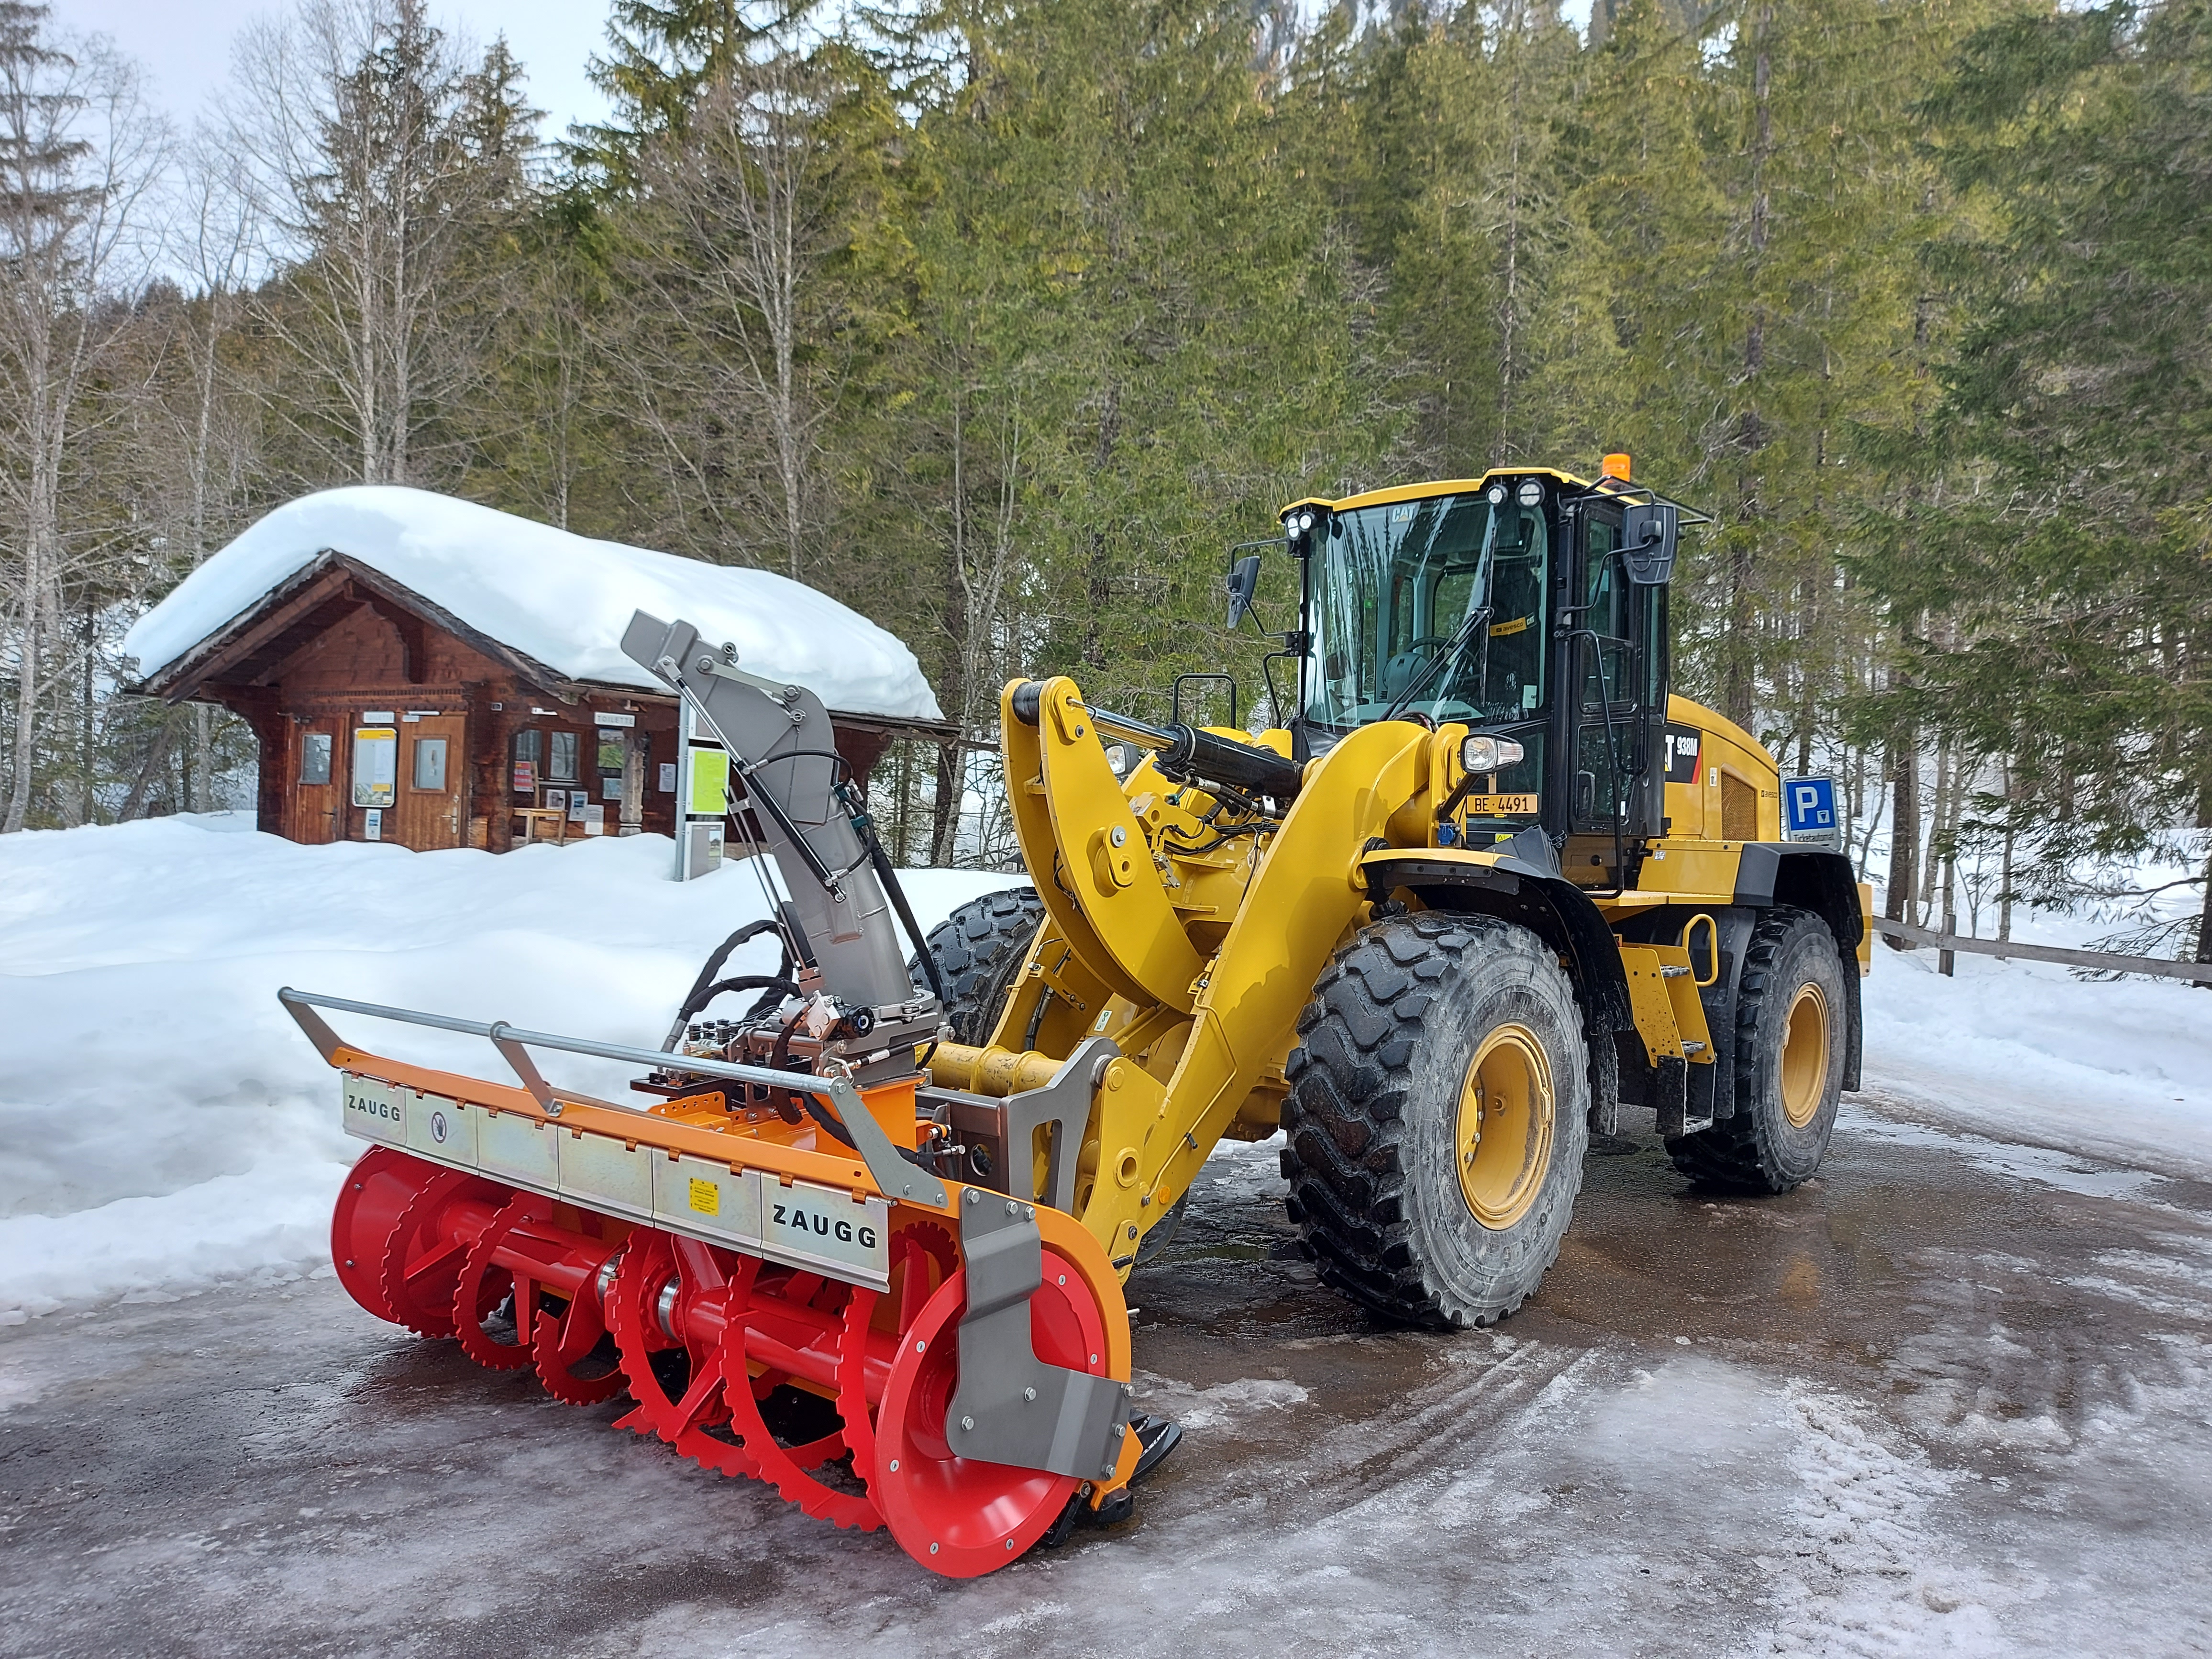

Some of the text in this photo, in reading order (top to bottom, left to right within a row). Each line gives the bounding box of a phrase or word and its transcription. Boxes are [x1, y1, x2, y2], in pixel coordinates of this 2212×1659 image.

[1392, 505, 1416, 523] CAT
[1503, 622, 1523, 631] avesco
[597, 716, 633, 725] TOILETTE
[1677, 736, 1698, 757] 938M
[1795, 786, 1818, 822] P
[1793, 831, 1835, 842] Ticketautomat
[348, 1095, 400, 1121] ZAUGG
[773, 1204, 876, 1249] ZAUGG
